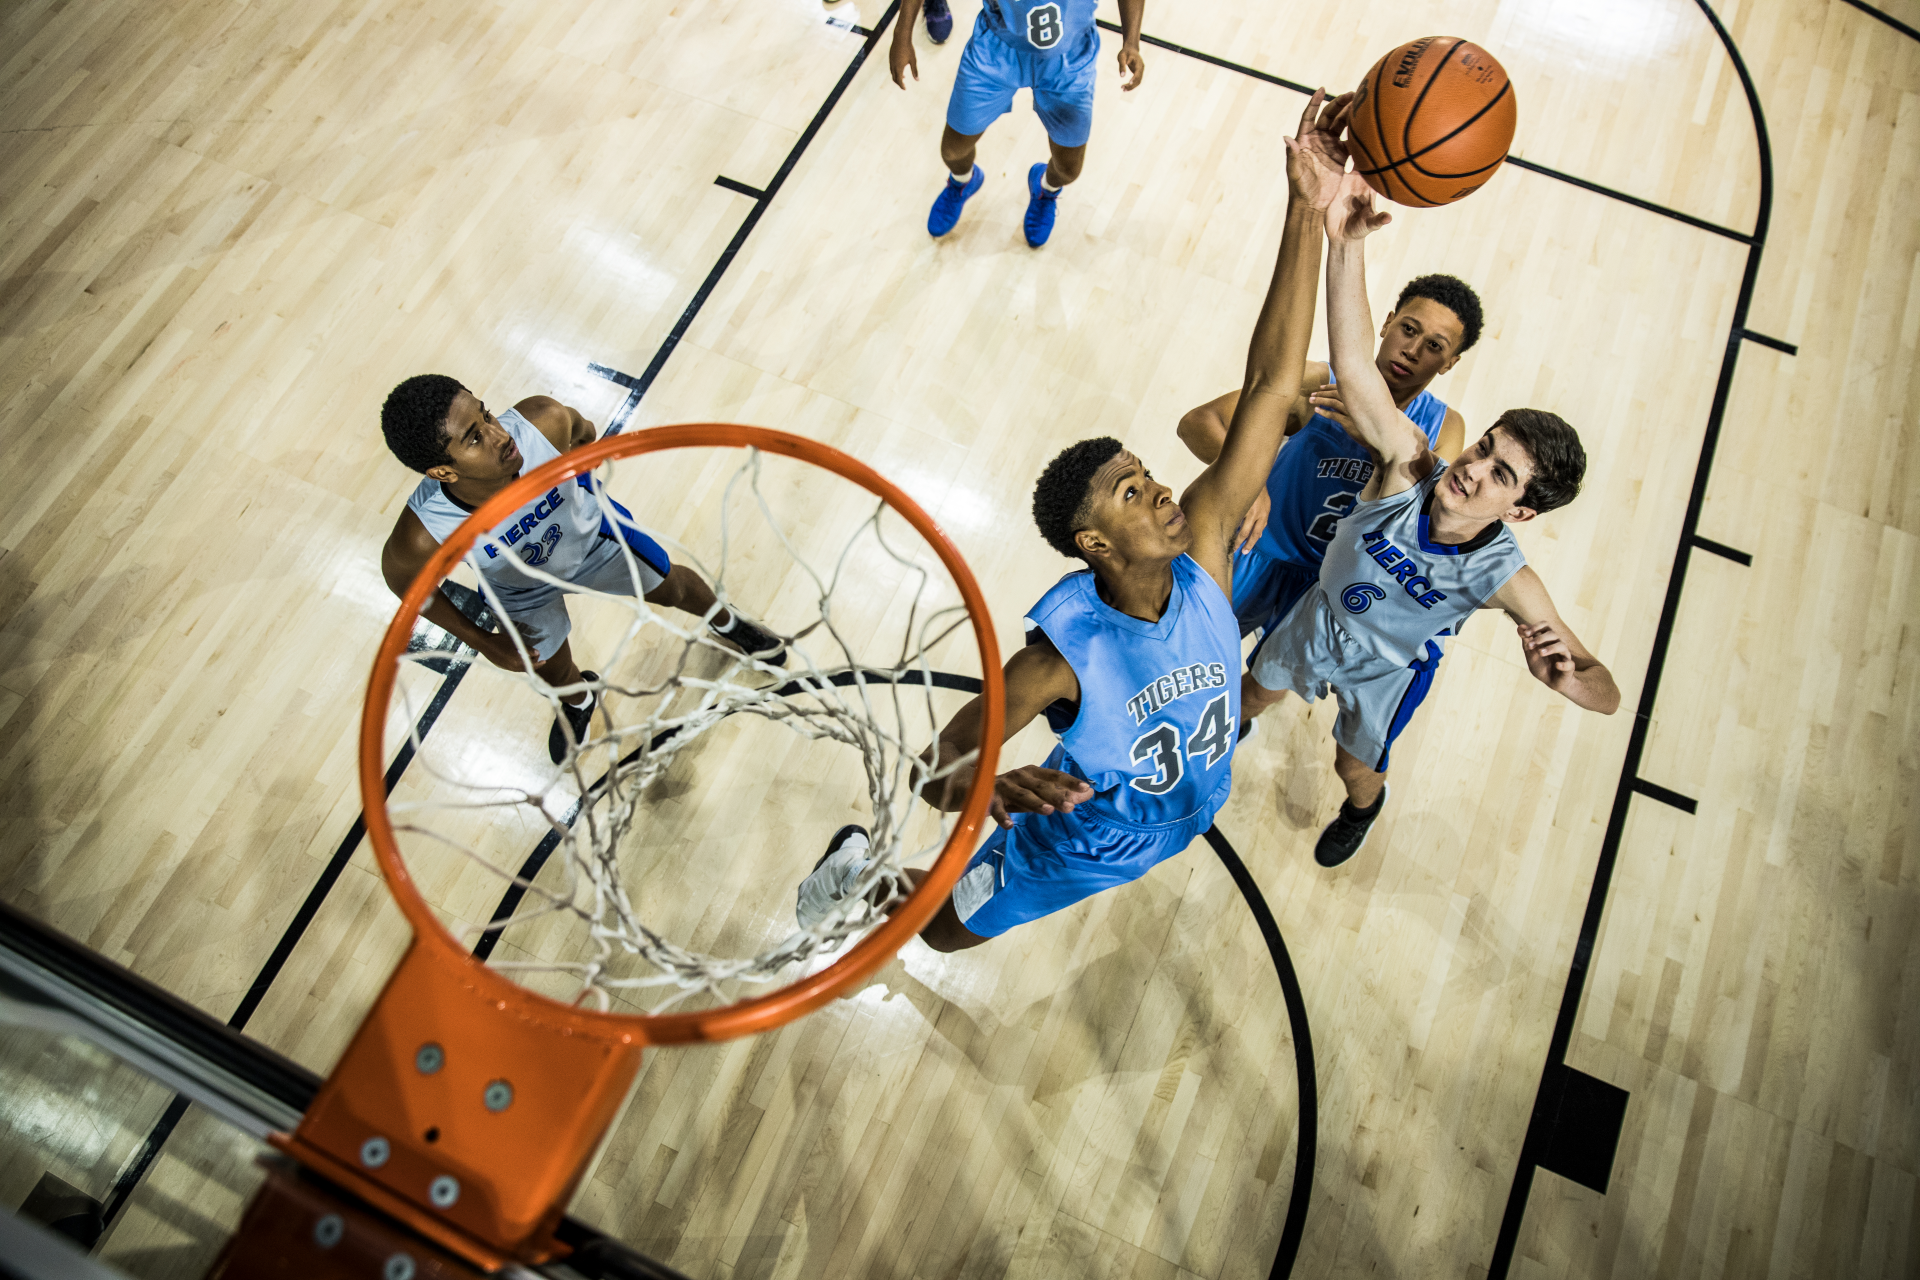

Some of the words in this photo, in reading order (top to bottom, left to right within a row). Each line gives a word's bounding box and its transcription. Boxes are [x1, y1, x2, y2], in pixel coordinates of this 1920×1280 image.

[1026, 2, 1063, 50] 8
[1317, 457, 1375, 485] TIGE
[520, 523, 563, 567] 23
[1340, 582, 1386, 614] 6
[1126, 662, 1227, 727] TIGERS
[1129, 689, 1235, 796] 34
